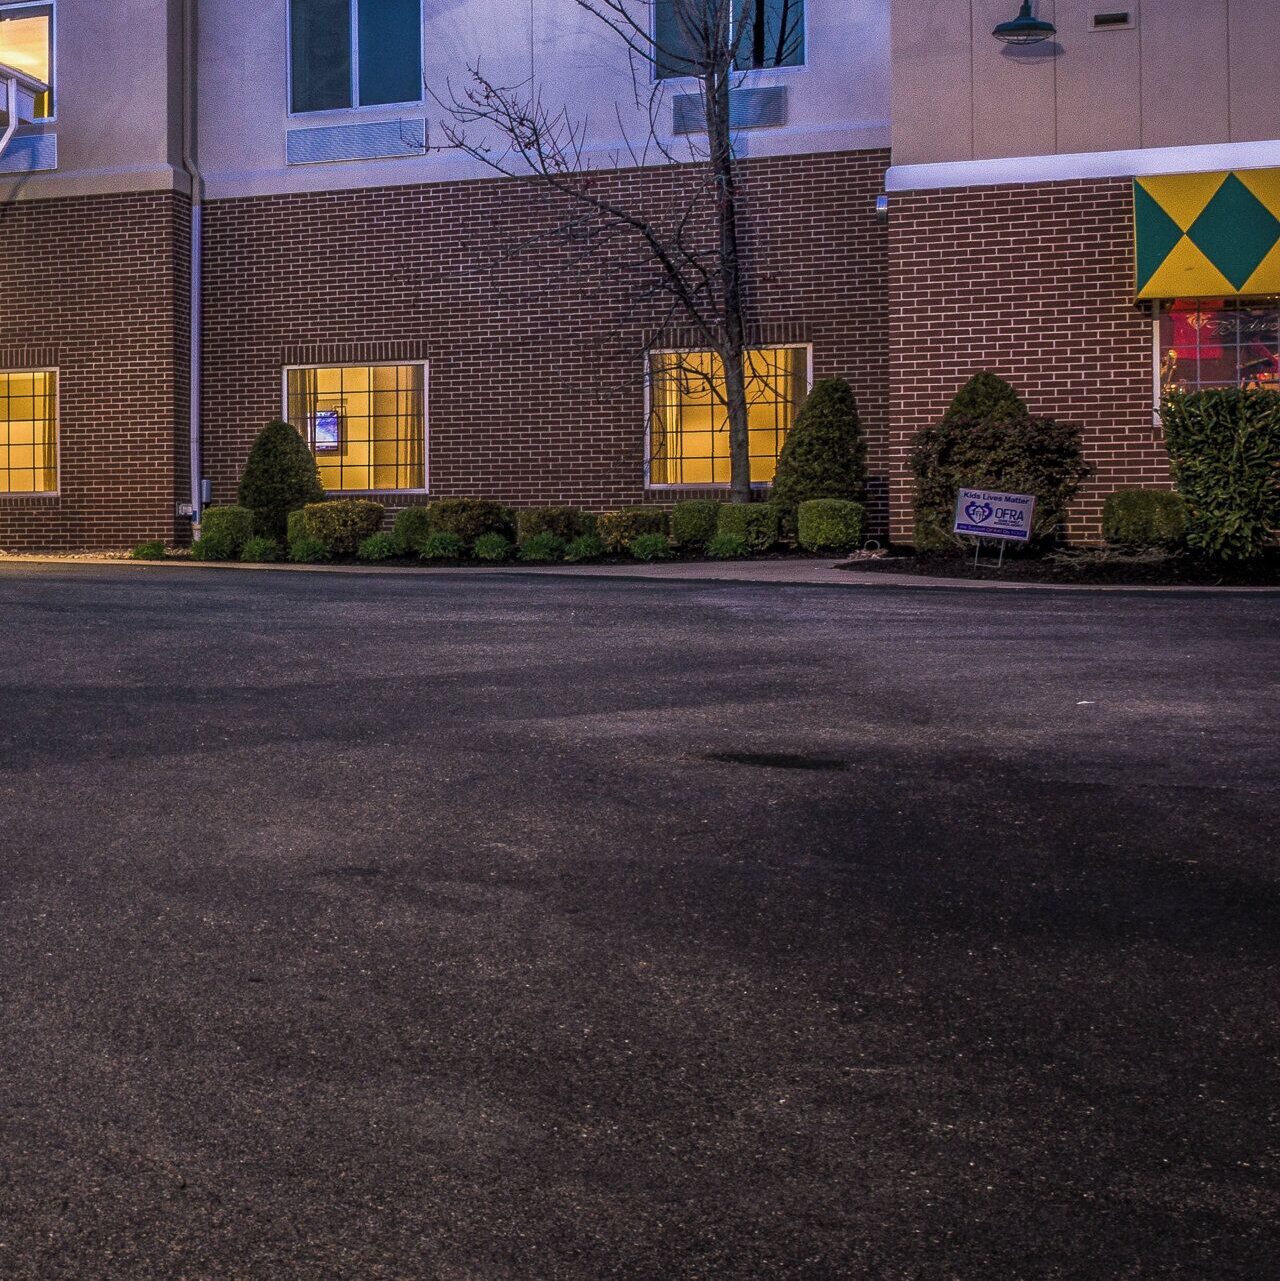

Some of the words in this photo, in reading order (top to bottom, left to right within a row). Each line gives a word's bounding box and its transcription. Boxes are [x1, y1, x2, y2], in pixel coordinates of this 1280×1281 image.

[963, 491, 981, 499] Kids
[982, 493, 1003, 502] Lives
[1004, 496, 1030, 504] Matter
[994, 507, 1024, 521] OFRA
